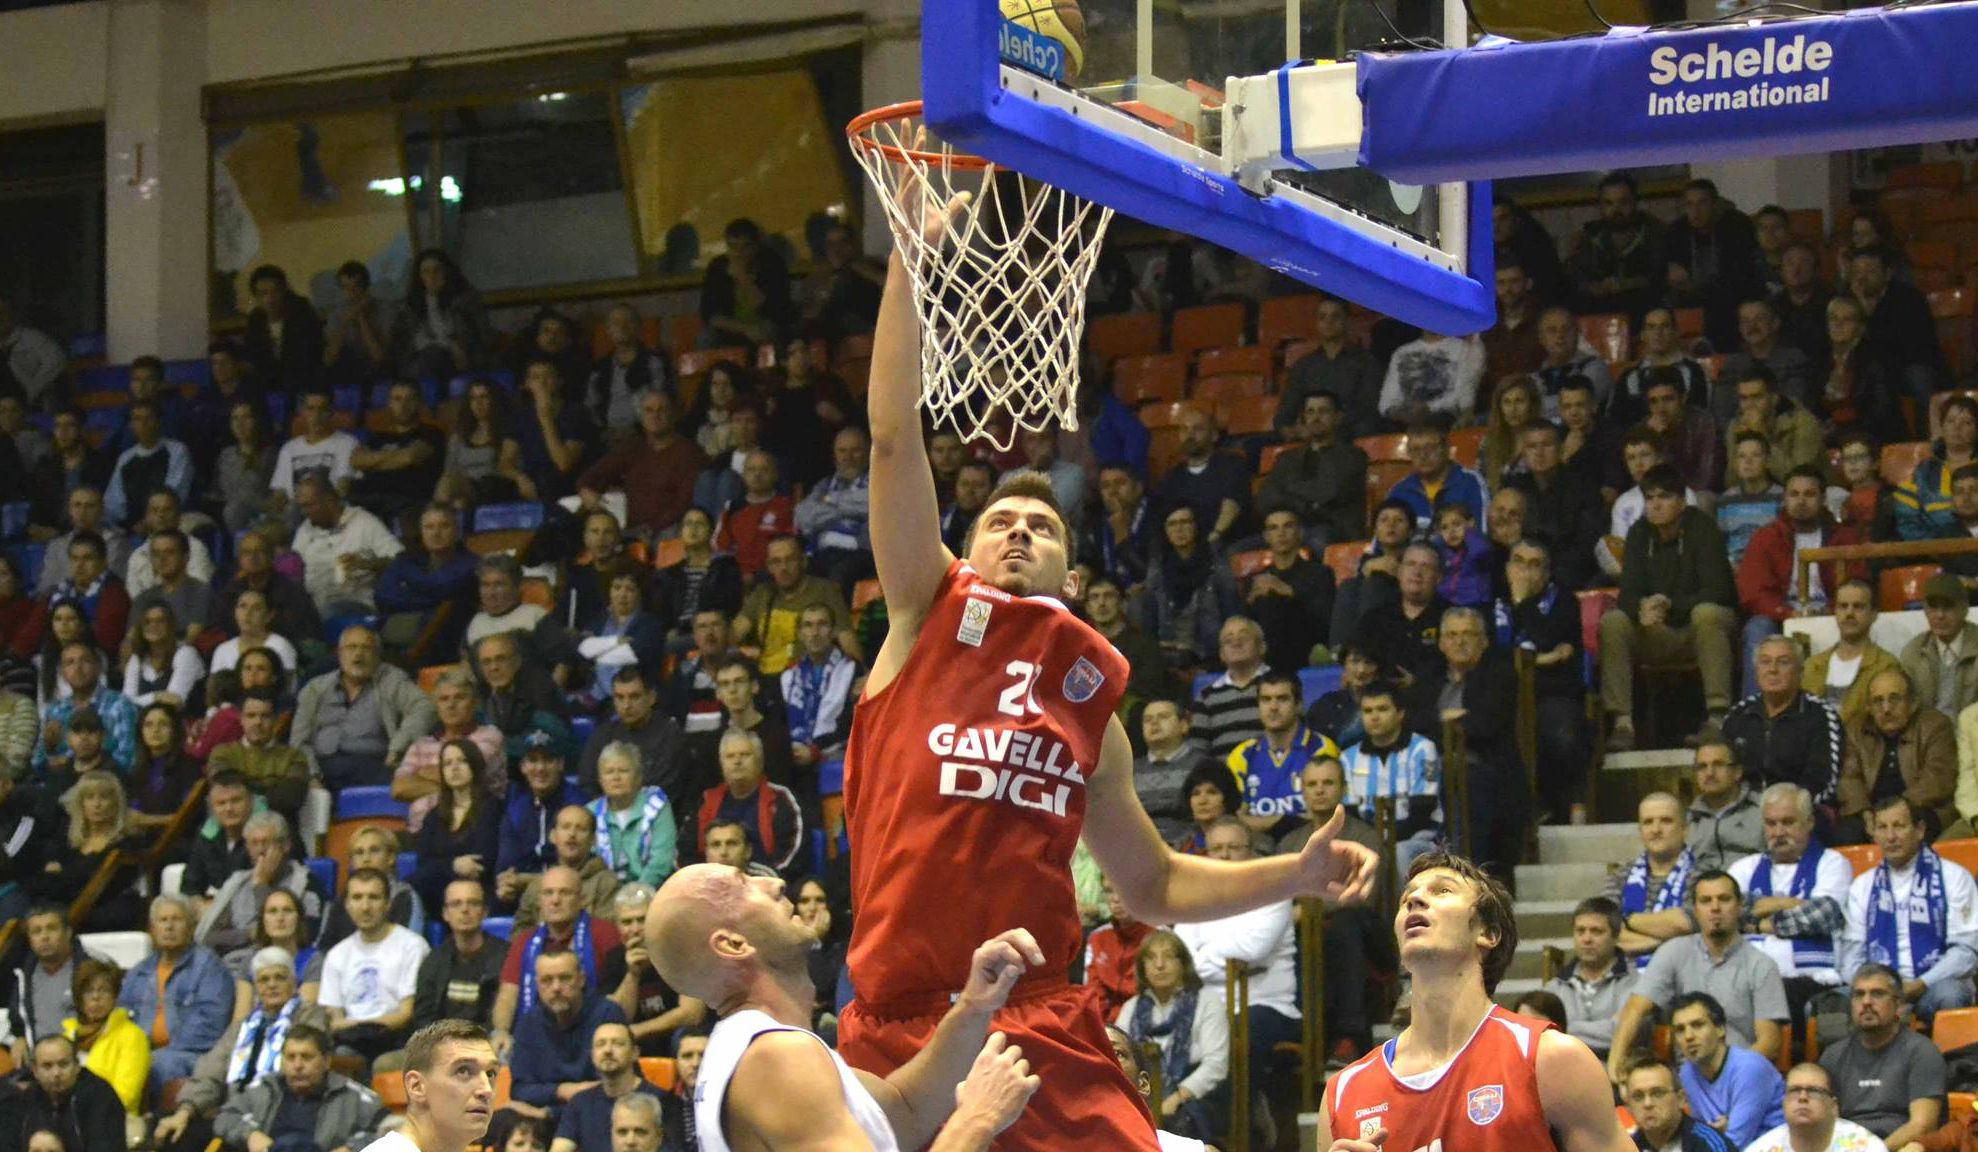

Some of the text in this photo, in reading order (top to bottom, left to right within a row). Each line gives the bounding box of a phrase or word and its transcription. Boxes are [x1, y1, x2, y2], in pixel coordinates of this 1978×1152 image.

[1649, 35, 1832, 85] Schelde
[1648, 77, 1829, 116] International
[939, 761, 1071, 817] DIGI
